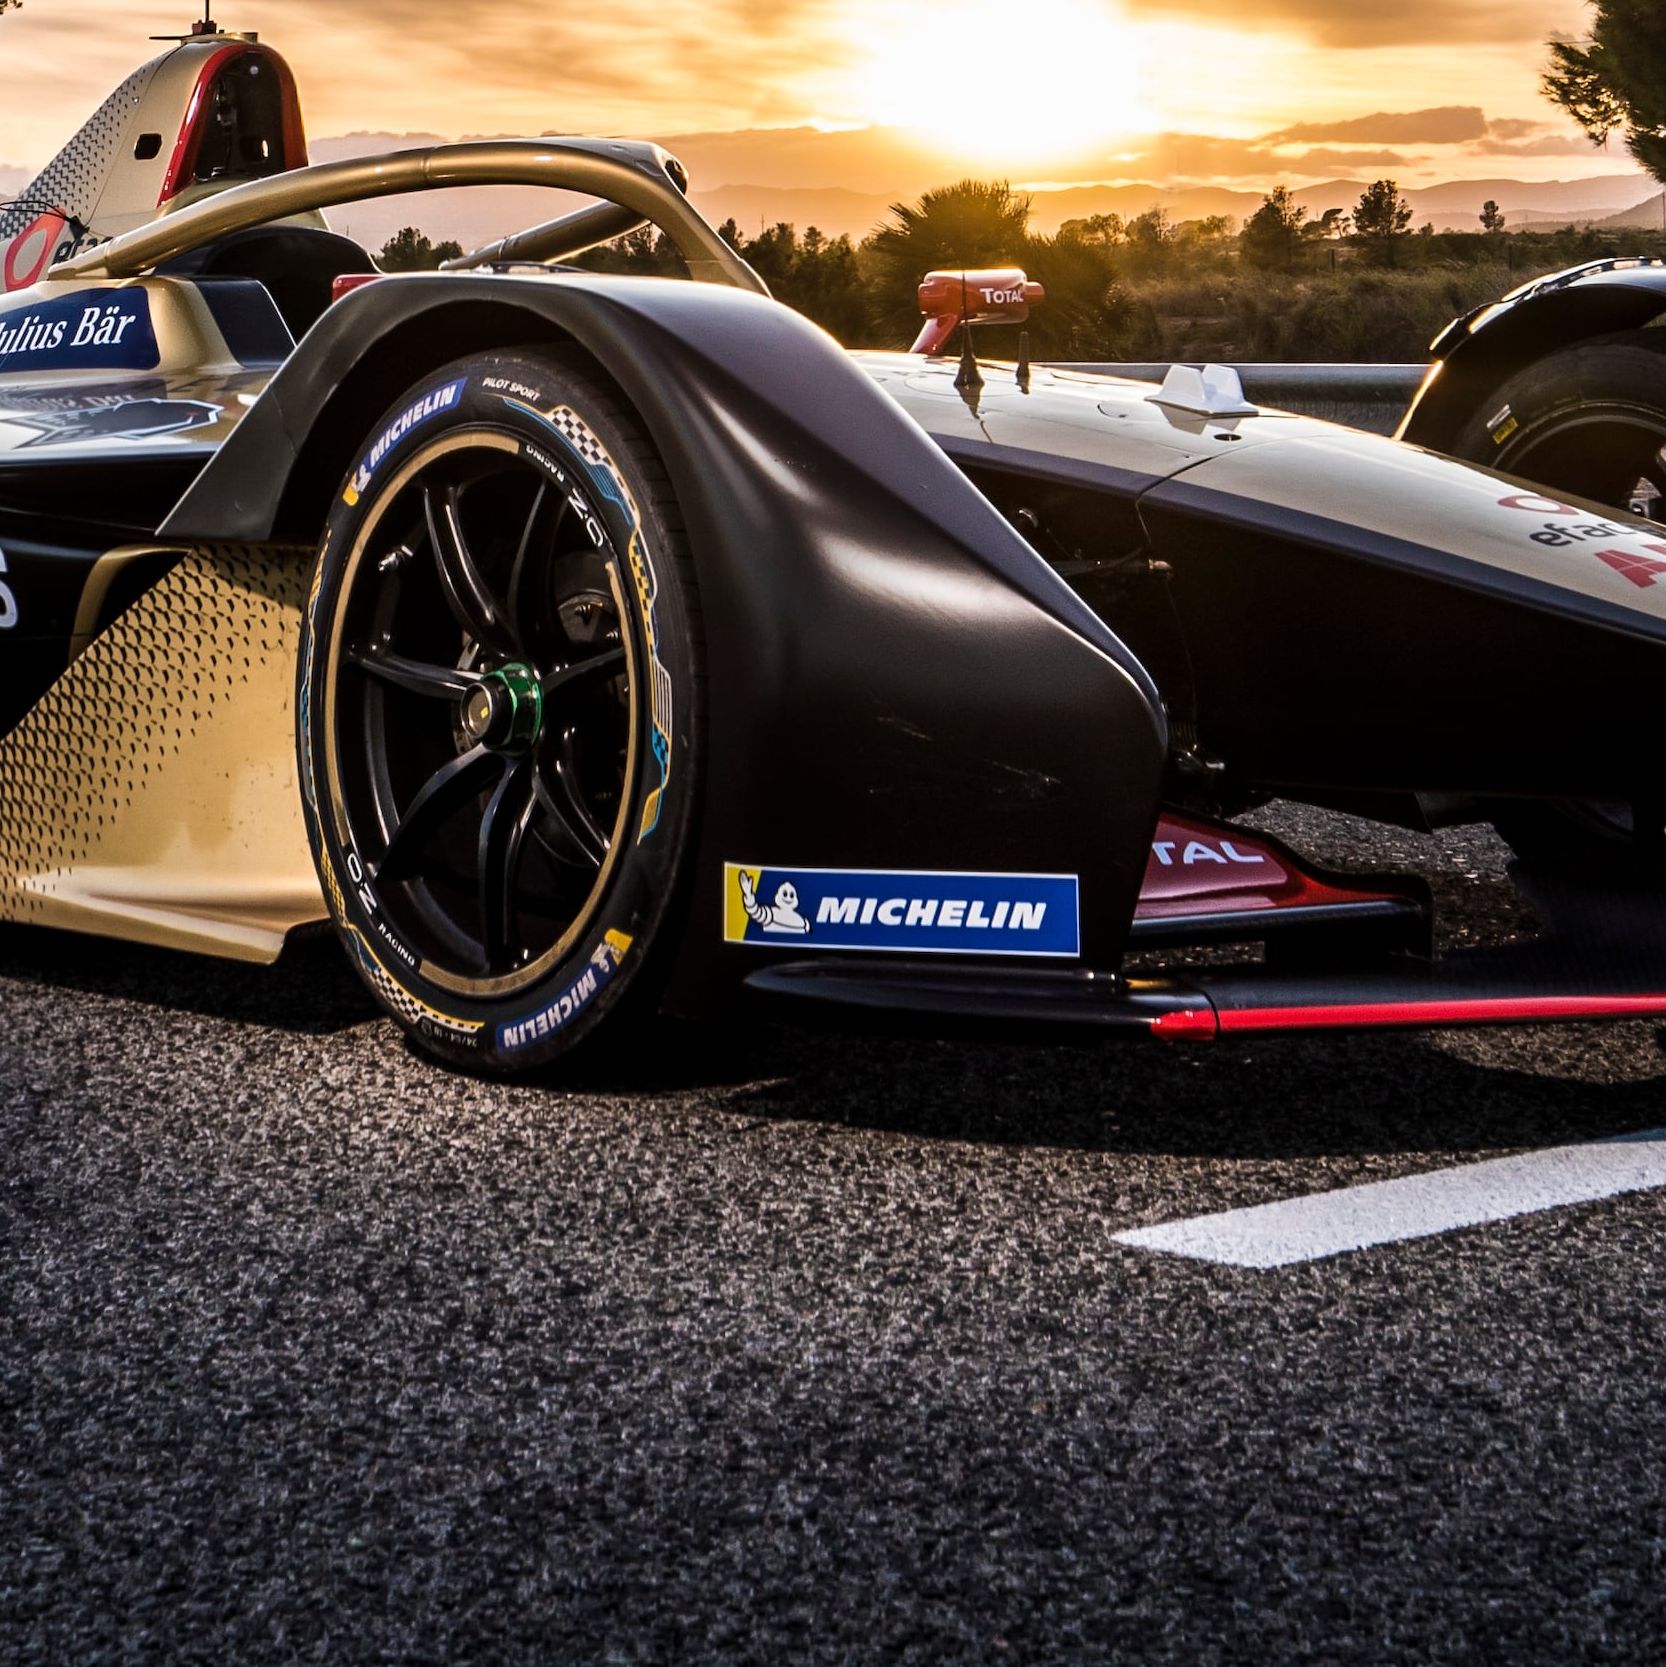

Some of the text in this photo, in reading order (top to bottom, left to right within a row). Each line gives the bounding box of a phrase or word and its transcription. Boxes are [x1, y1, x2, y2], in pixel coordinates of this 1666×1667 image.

[979, 287, 1024, 304] TOTAL
[70, 306, 136, 346] Bär
[482, 377, 541, 401] PILOT SPORT
[370, 385, 457, 467] MICHELIN
[815, 896, 1047, 930] MICHELIN
[378, 923, 415, 966] RACING
[503, 968, 597, 1048] MICHELIN
